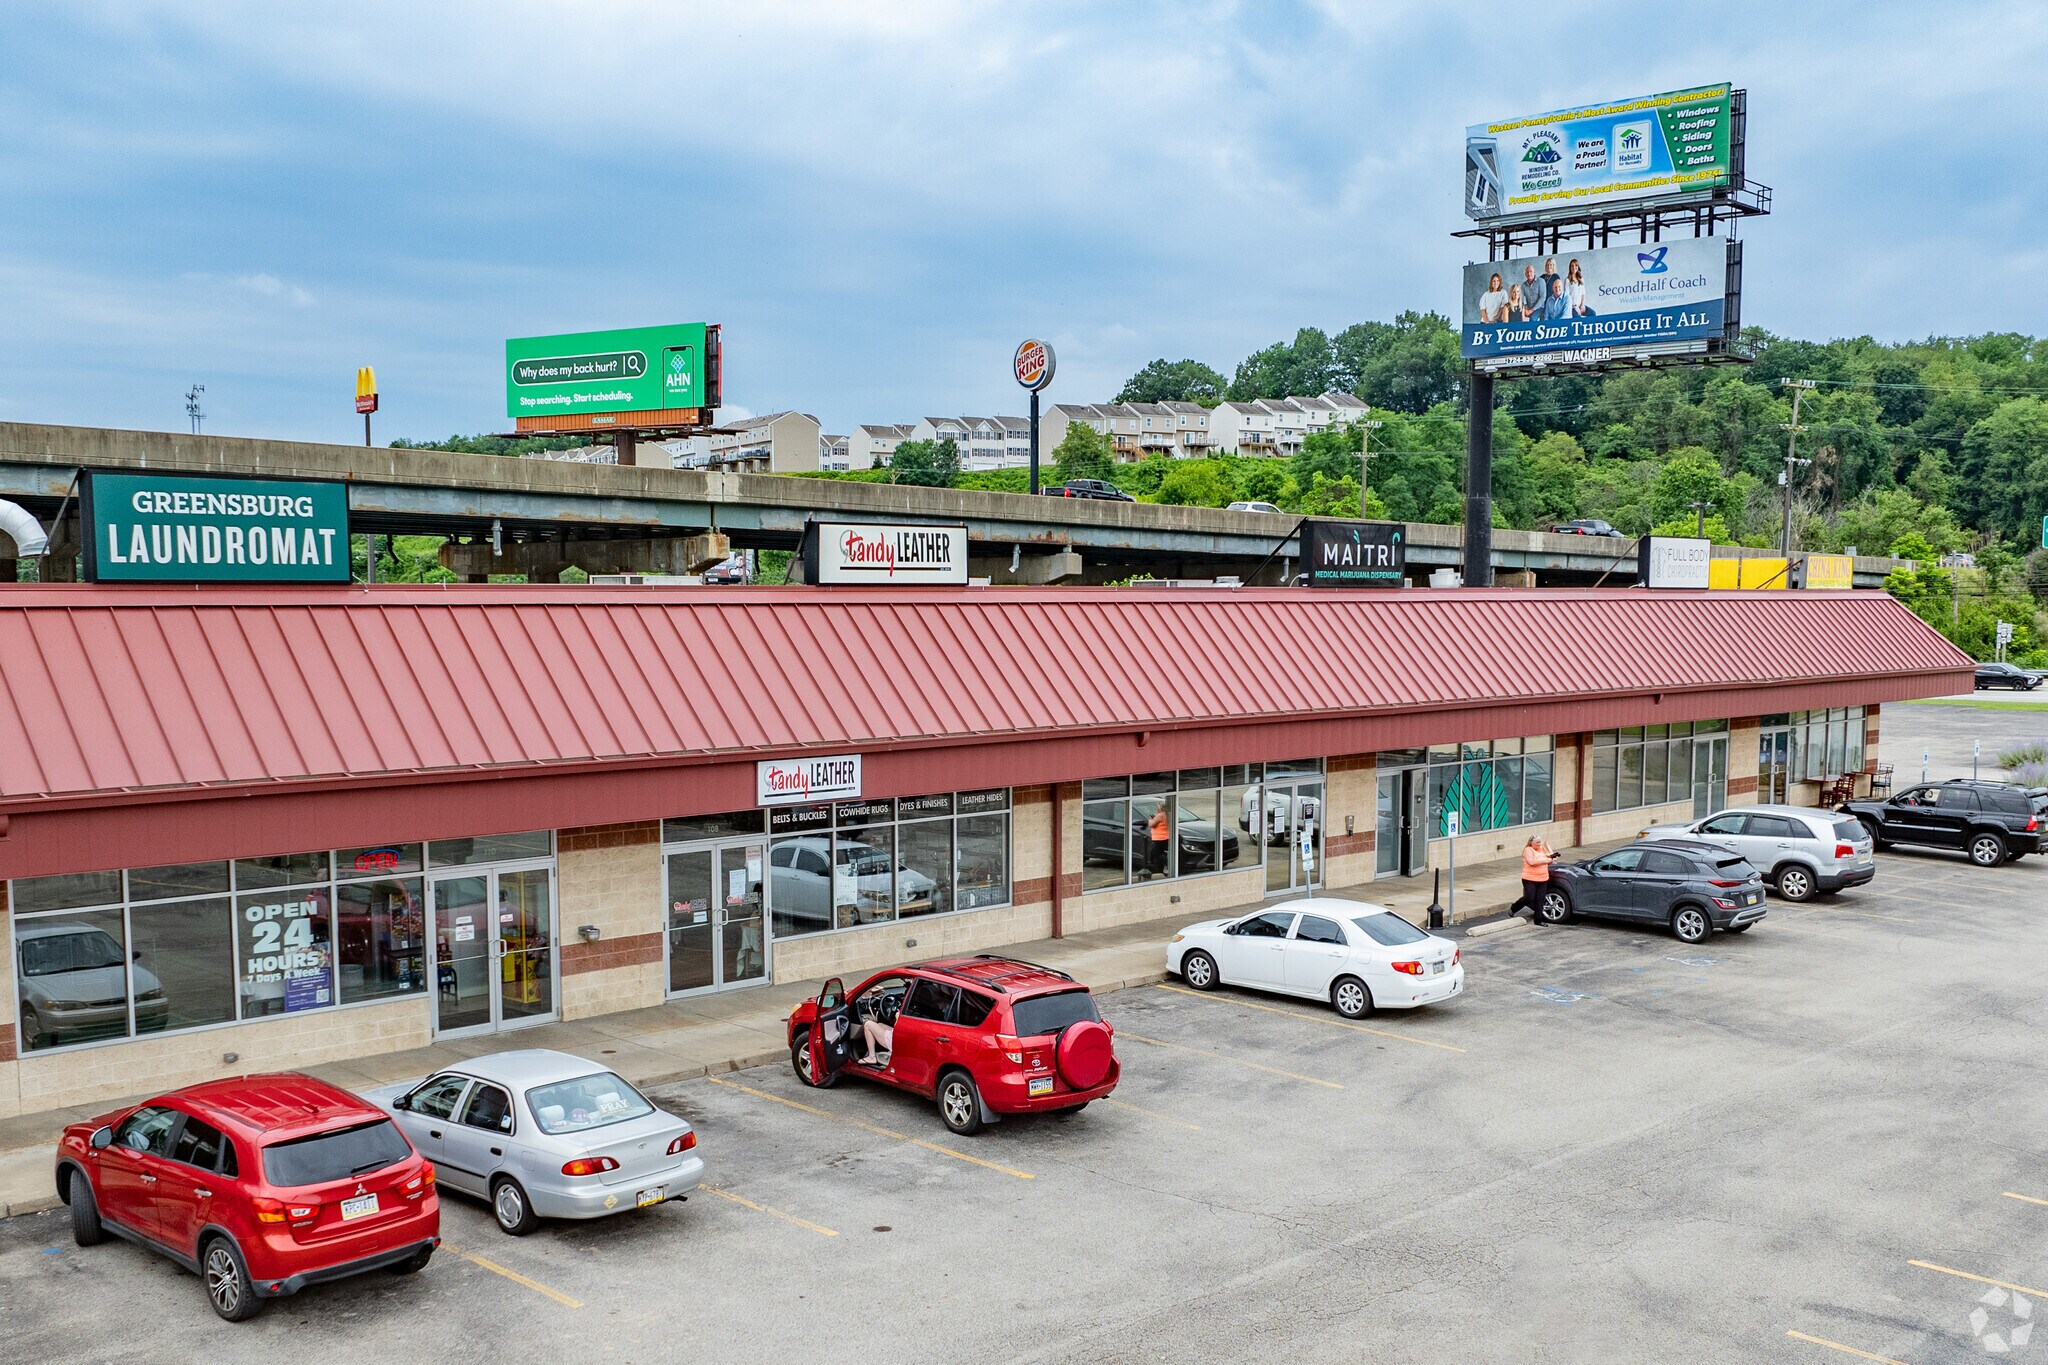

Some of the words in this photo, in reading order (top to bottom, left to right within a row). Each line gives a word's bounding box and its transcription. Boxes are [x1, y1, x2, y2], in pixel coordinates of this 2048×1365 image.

[1488, 121, 1520, 134] Western
[1521, 111, 1582, 127] Pennsylvania's
[1583, 107, 1604, 117] Most
[1604, 103, 1633, 114] Award
[1635, 97, 1671, 109] Winning
[1674, 87, 1725, 103] Contractor!
[1676, 105, 1720, 119] Windows
[1679, 118, 1716, 131] Roofing
[1532, 130, 1560, 144] PLEASANT
[1578, 141, 1589, 149] We
[1591, 139, 1604, 147] are
[1682, 131, 1713, 143] Siding
[1582, 149, 1606, 160] Proud
[1684, 143, 1713, 154] Doors
[1619, 153, 1642, 162] Habitat
[1687, 154, 1714, 166] Baths
[1574, 160, 1606, 170] Partner!
[1521, 171, 1551, 180] REMODELING
[1508, 194, 1540, 206] Proudly
[1541, 190, 1572, 202] Serving
[1573, 187, 1590, 197] Our
[1591, 184, 1612, 195] Local
[1613, 176, 1670, 191] Communities
[1671, 173, 1694, 184] Since
[1522, 181, 1536, 191] We
[1537, 178, 1562, 188] Care!
[1598, 278, 1667, 297] SecondHalf
[1669, 274, 1707, 290] Coach
[1619, 295, 1642, 304] Wealth
[1643, 292, 1685, 303] Management
[1017, 346, 1043, 367] BURGER
[1564, 348, 1610, 362] WAGNER
[519, 366, 537, 380] Why
[538, 364, 558, 377] does
[559, 364, 572, 376] my
[573, 362, 594, 374] back
[595, 360, 617, 372] hurt?
[1018, 354, 1045, 380] KING
[665, 372, 691, 387] AHN
[520, 396, 536, 407] Stop
[536, 394, 572, 406] searching.
[573, 393, 591, 403] Start
[592, 390, 633, 402] scheduling.
[132, 491, 314, 518] GREENSBURG
[108, 523, 336, 566] LAUNDROMAT
[896, 532, 951, 563] LEATHER
[1668, 548, 1687, 561] FULL
[1689, 549, 1709, 562] BODY
[1315, 570, 1340, 579] MEDICAL
[1340, 570, 1370, 579] MARIJUANA
[1370, 571, 1402, 579] DISPENSARY
[810, 760, 855, 787] LEATHER
[899, 801, 915, 811] DYES
[916, 800, 921, 809] &
[922, 798, 948, 809] FINISHES
[962, 794, 985, 805] LEATHER
[986, 793, 1003, 802] HIDES
[772, 813, 790, 824] BELTS
[791, 813, 798, 822] &
[799, 810, 827, 822] BUCKLES
[839, 807, 870, 817] COWHIDE
[871, 804, 888, 815] RUGS
[354, 853, 398, 872] OPEN
[245, 900, 318, 922] OPEN
[252, 918, 314, 954] 24
[247, 951, 320, 974] HOURS
[247, 975, 254, 984] 7
[256, 973, 282, 983] Days
[284, 970, 295, 980] A
[295, 967, 321, 978] Week
